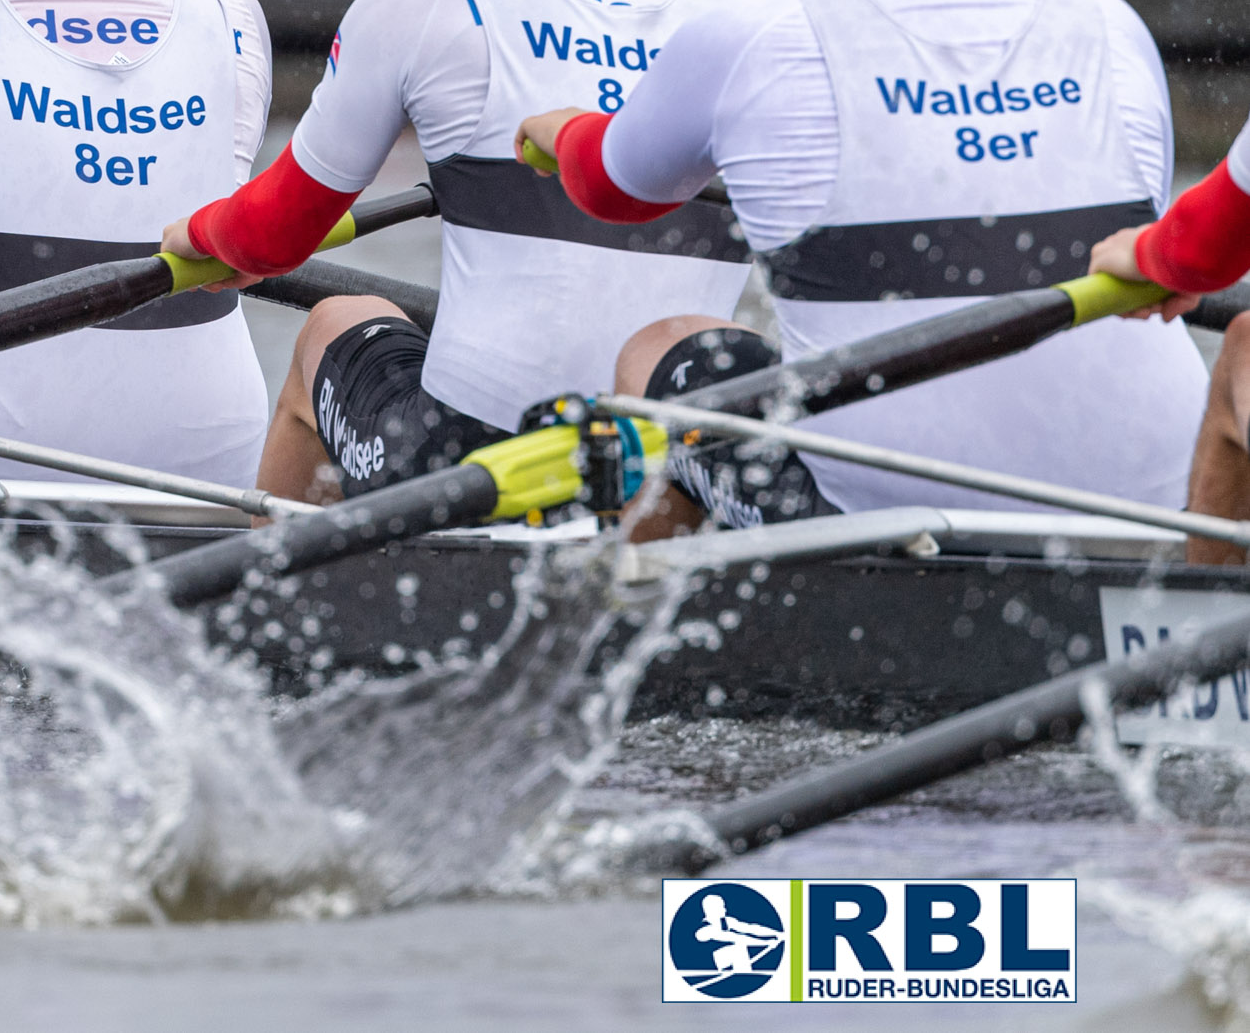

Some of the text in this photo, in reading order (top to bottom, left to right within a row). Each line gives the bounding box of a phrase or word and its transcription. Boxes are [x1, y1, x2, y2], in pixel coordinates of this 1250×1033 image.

[2, 79, 206, 134] Waldsee
[876, 76, 1081, 116] Waldsee
[74, 143, 157, 186] 8er
[956, 127, 1039, 163] 8er
